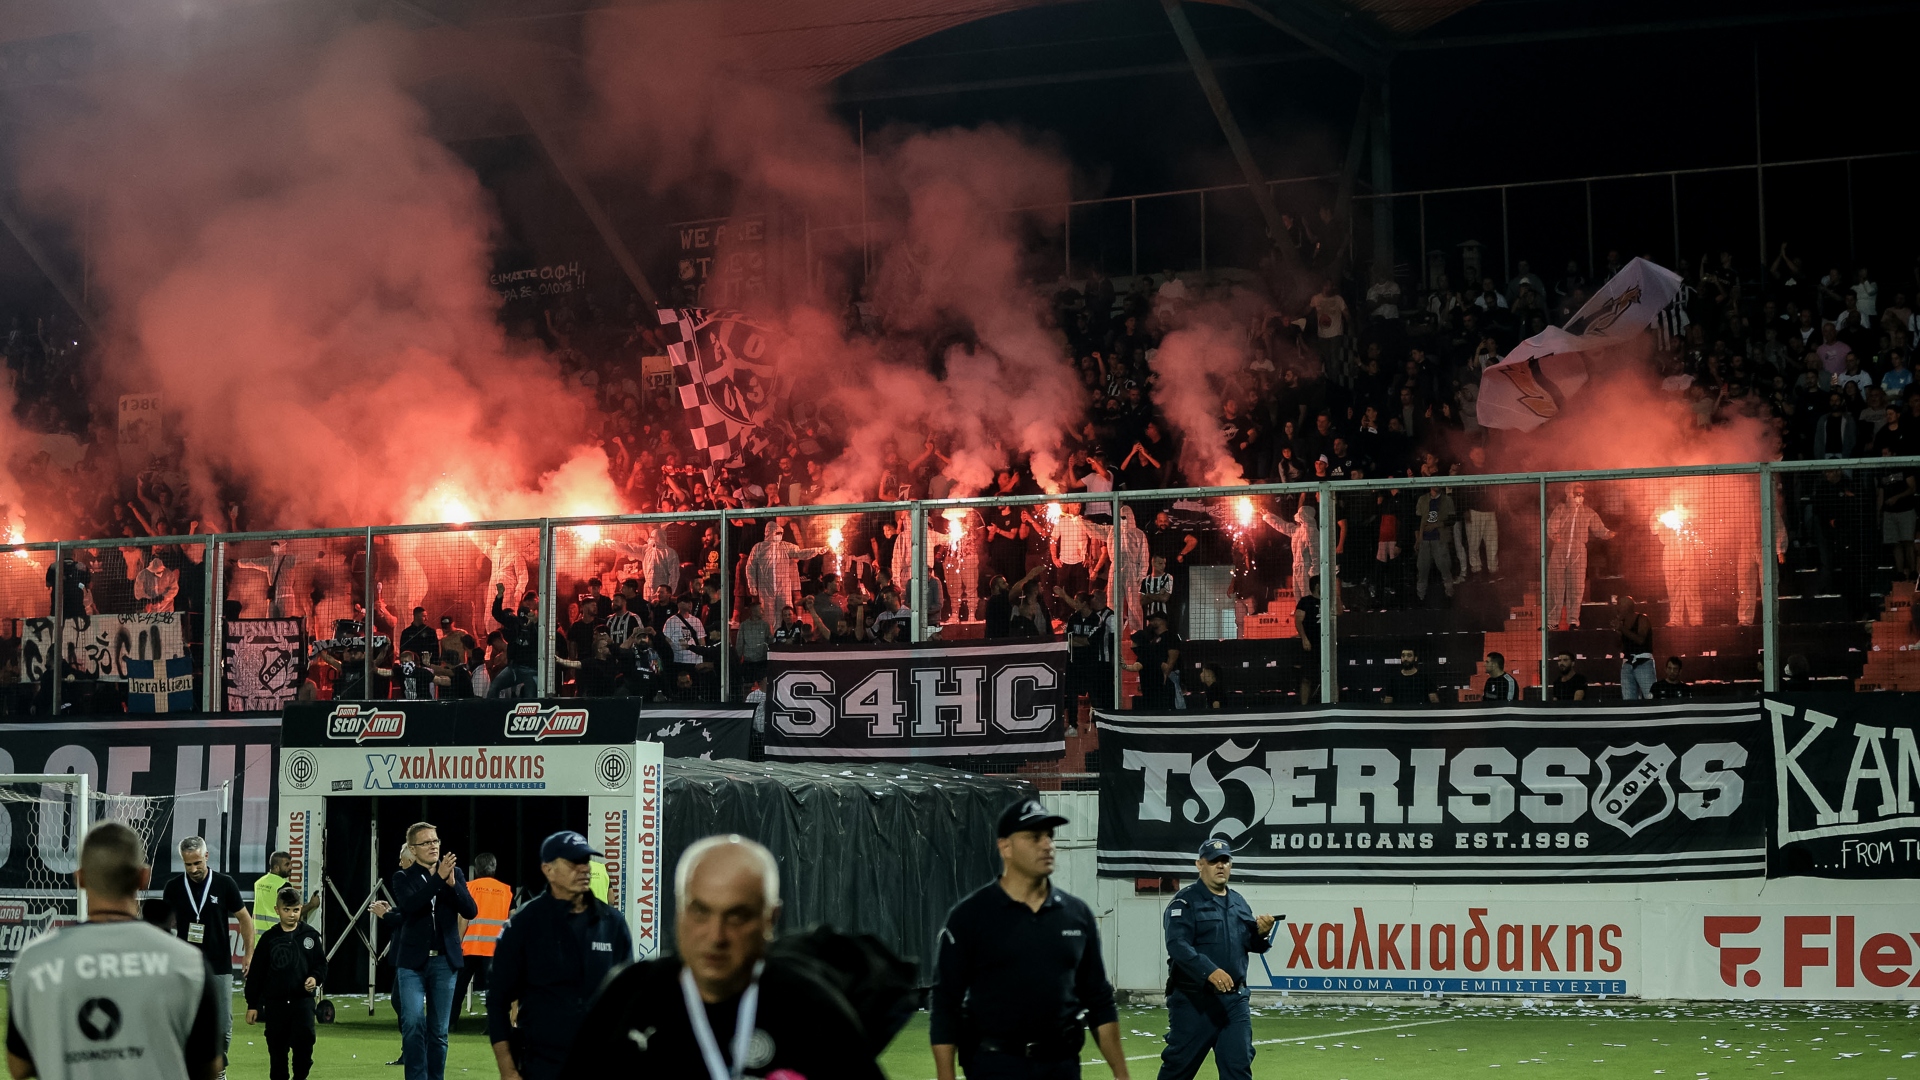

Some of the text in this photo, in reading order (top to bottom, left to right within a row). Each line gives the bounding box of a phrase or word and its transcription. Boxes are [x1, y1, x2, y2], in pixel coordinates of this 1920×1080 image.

[228, 621, 299, 637] MESSARA
[772, 662, 1059, 738] S4HC
[1270, 831, 1590, 850] HOOLIGANS EST.1996
[28, 951, 169, 992] TV CREW
[1285, 977, 1621, 993] ΤΟ ΟΝΟΜΑ ΠΟΥ ΕΜΠΙΣΤΕΥΕΣΤΕ
